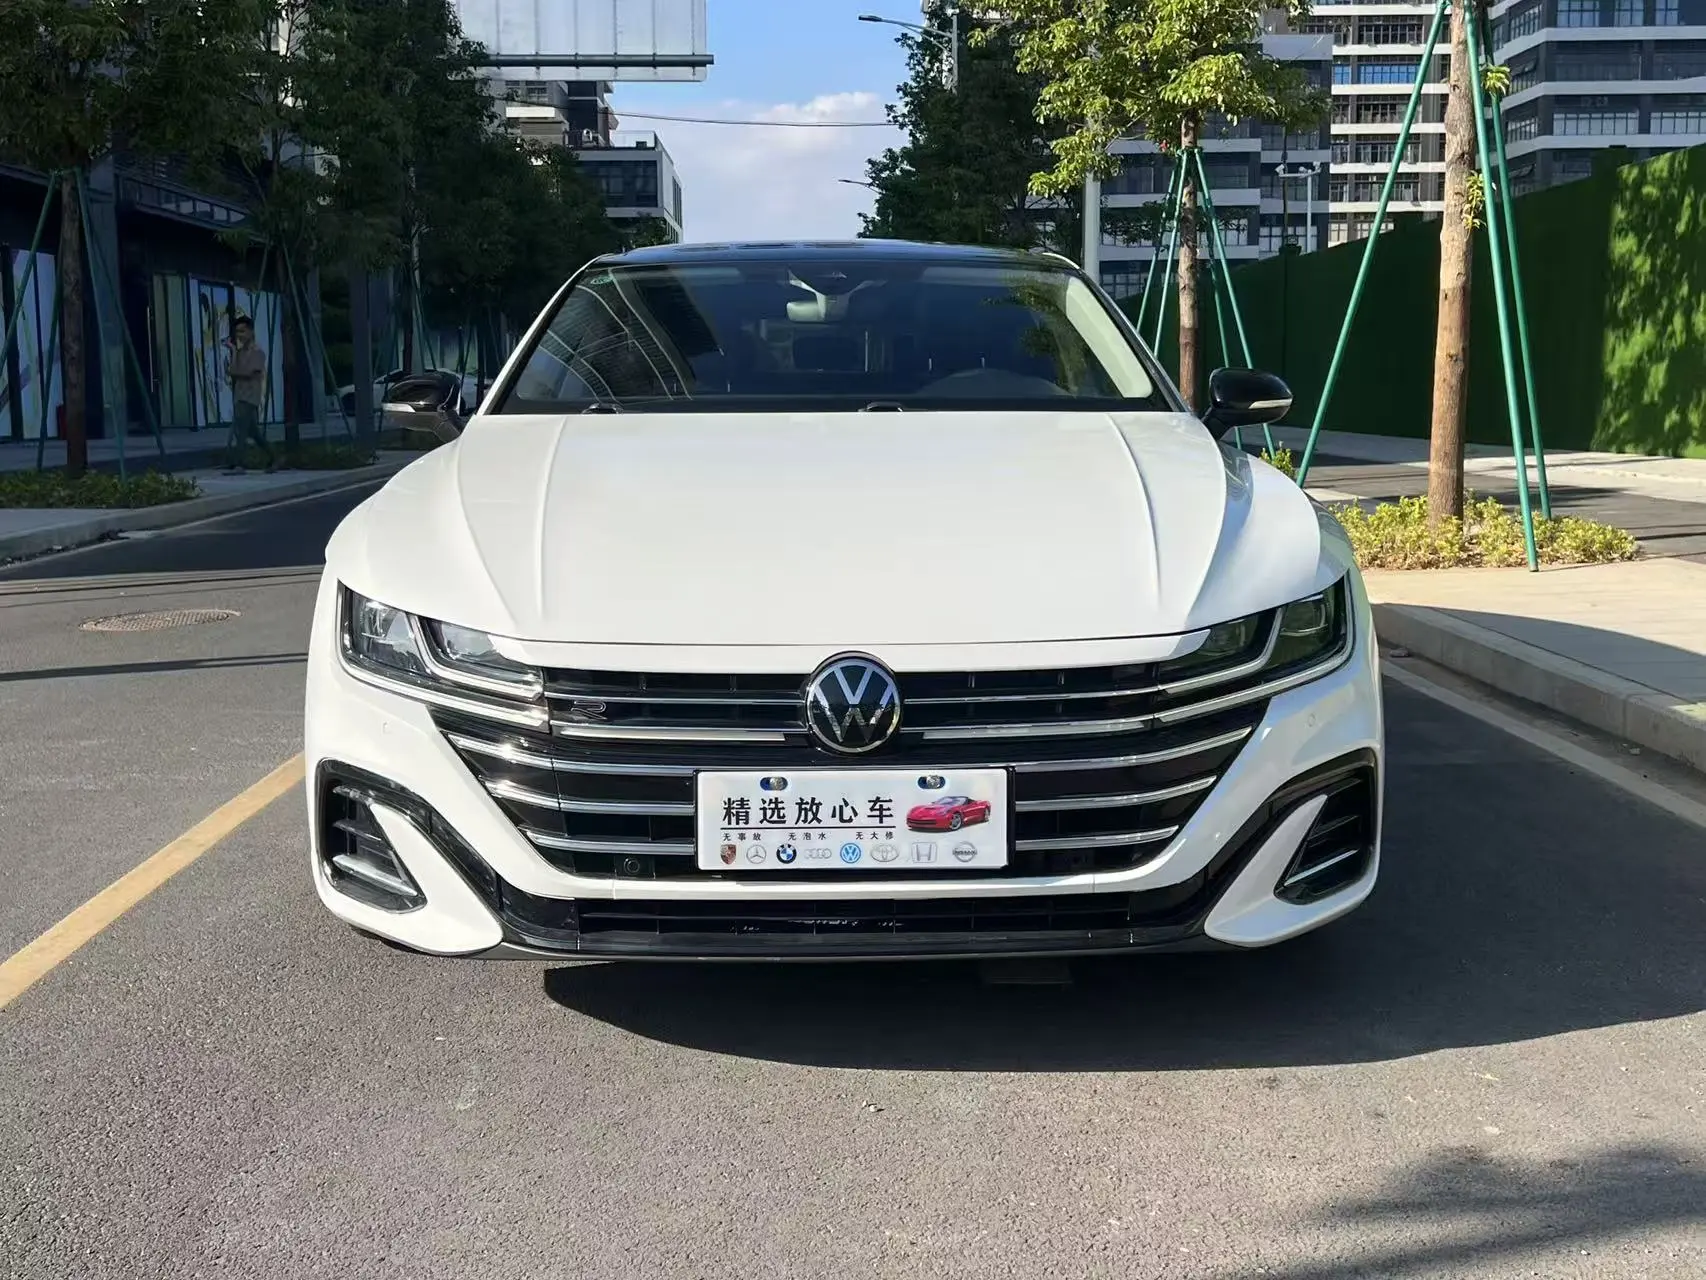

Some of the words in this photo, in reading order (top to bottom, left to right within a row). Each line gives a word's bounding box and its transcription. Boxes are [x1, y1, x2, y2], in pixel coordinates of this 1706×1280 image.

[722, 796, 894, 826] 精选放心车
[723, 832, 762, 841] 无事故
[788, 832, 827, 841] 无泡水
[855, 831, 894, 841] 无大修
